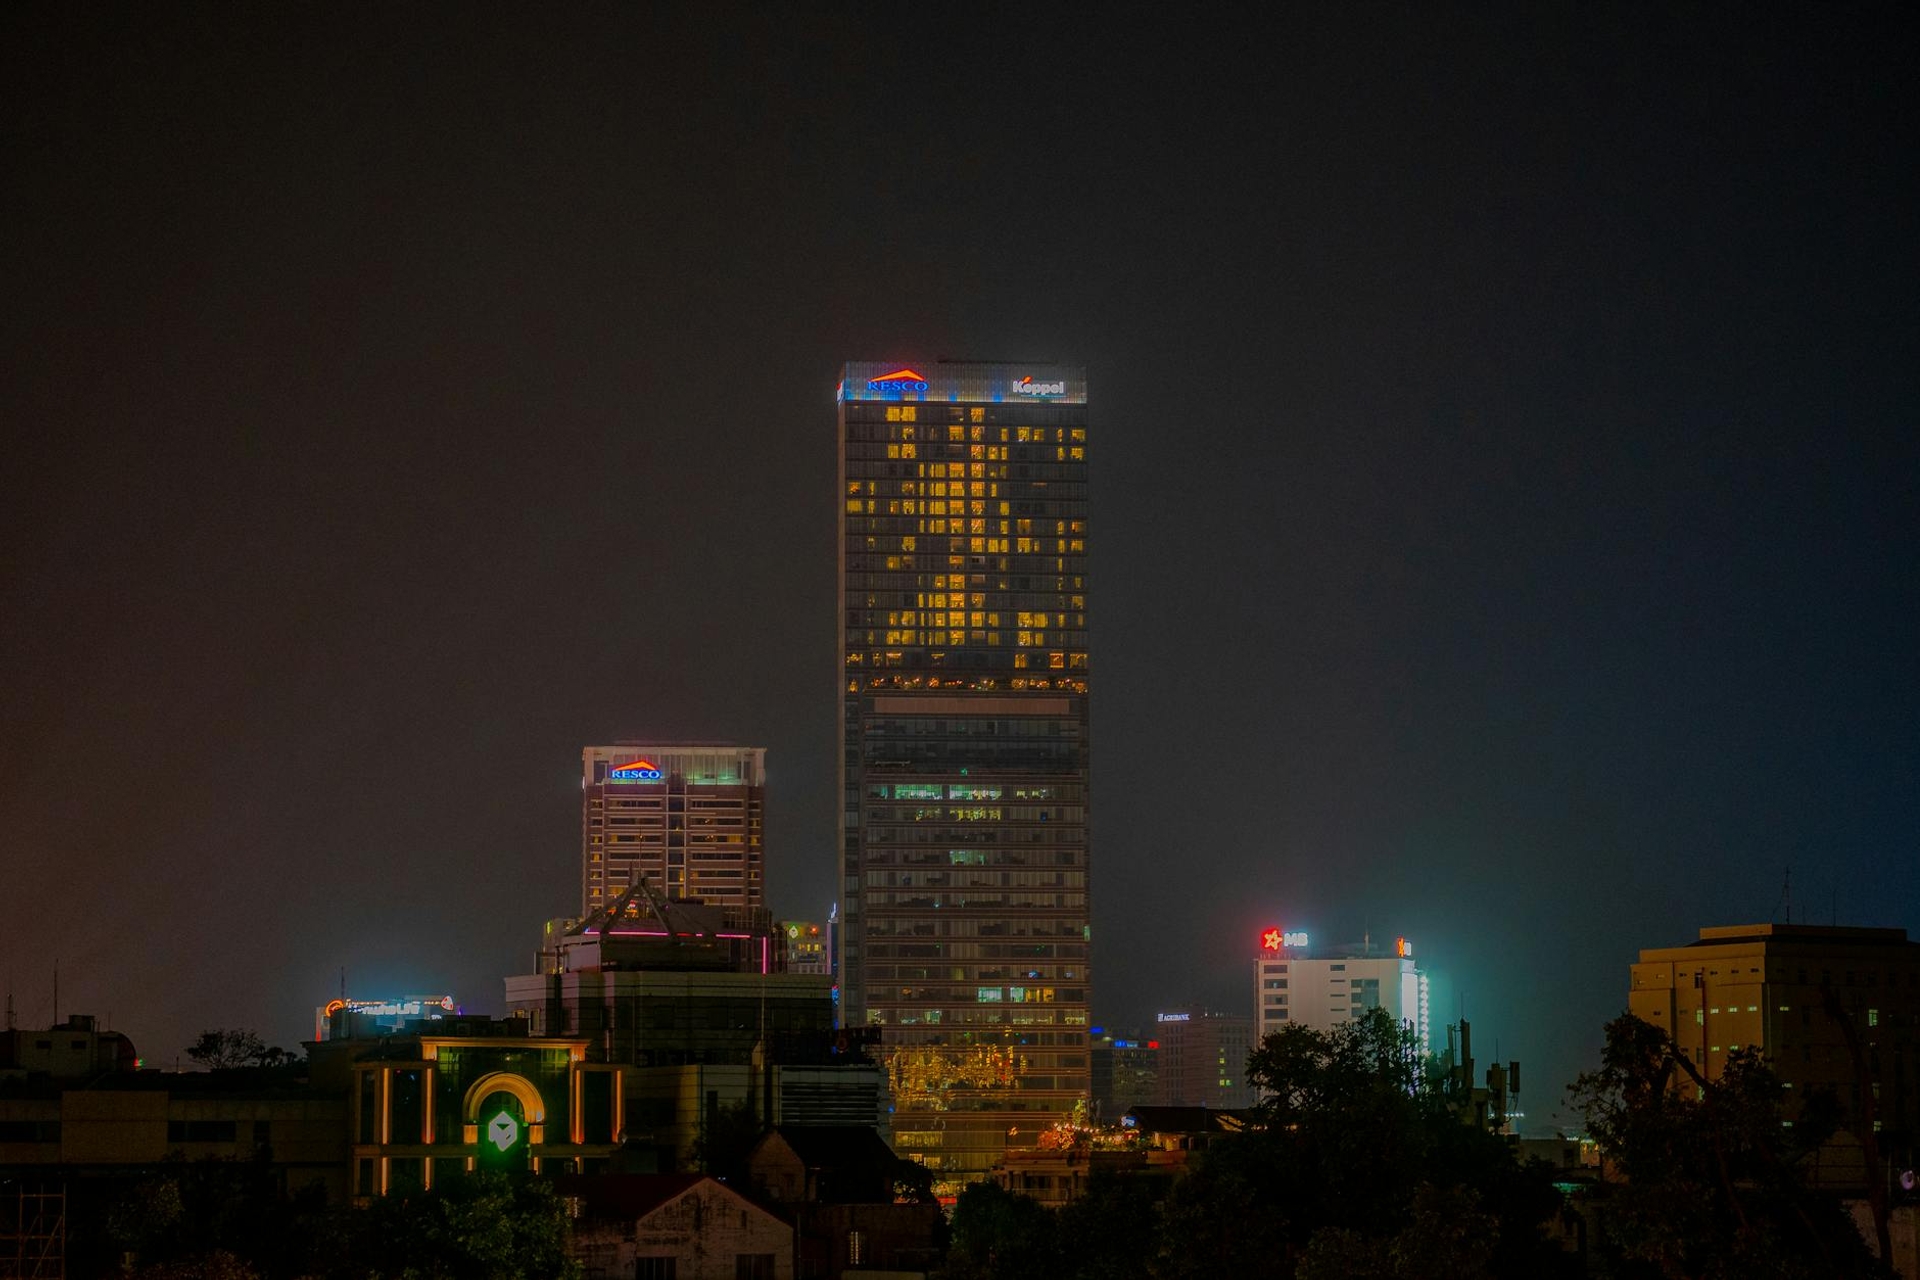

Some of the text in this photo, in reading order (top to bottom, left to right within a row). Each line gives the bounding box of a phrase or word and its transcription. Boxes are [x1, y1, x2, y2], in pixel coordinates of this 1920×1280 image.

[867, 381, 929, 392] RESCO
[1012, 380, 1064, 395] Keppel
[611, 770, 660, 779] RESCO
[1284, 932, 1308, 947] MB
